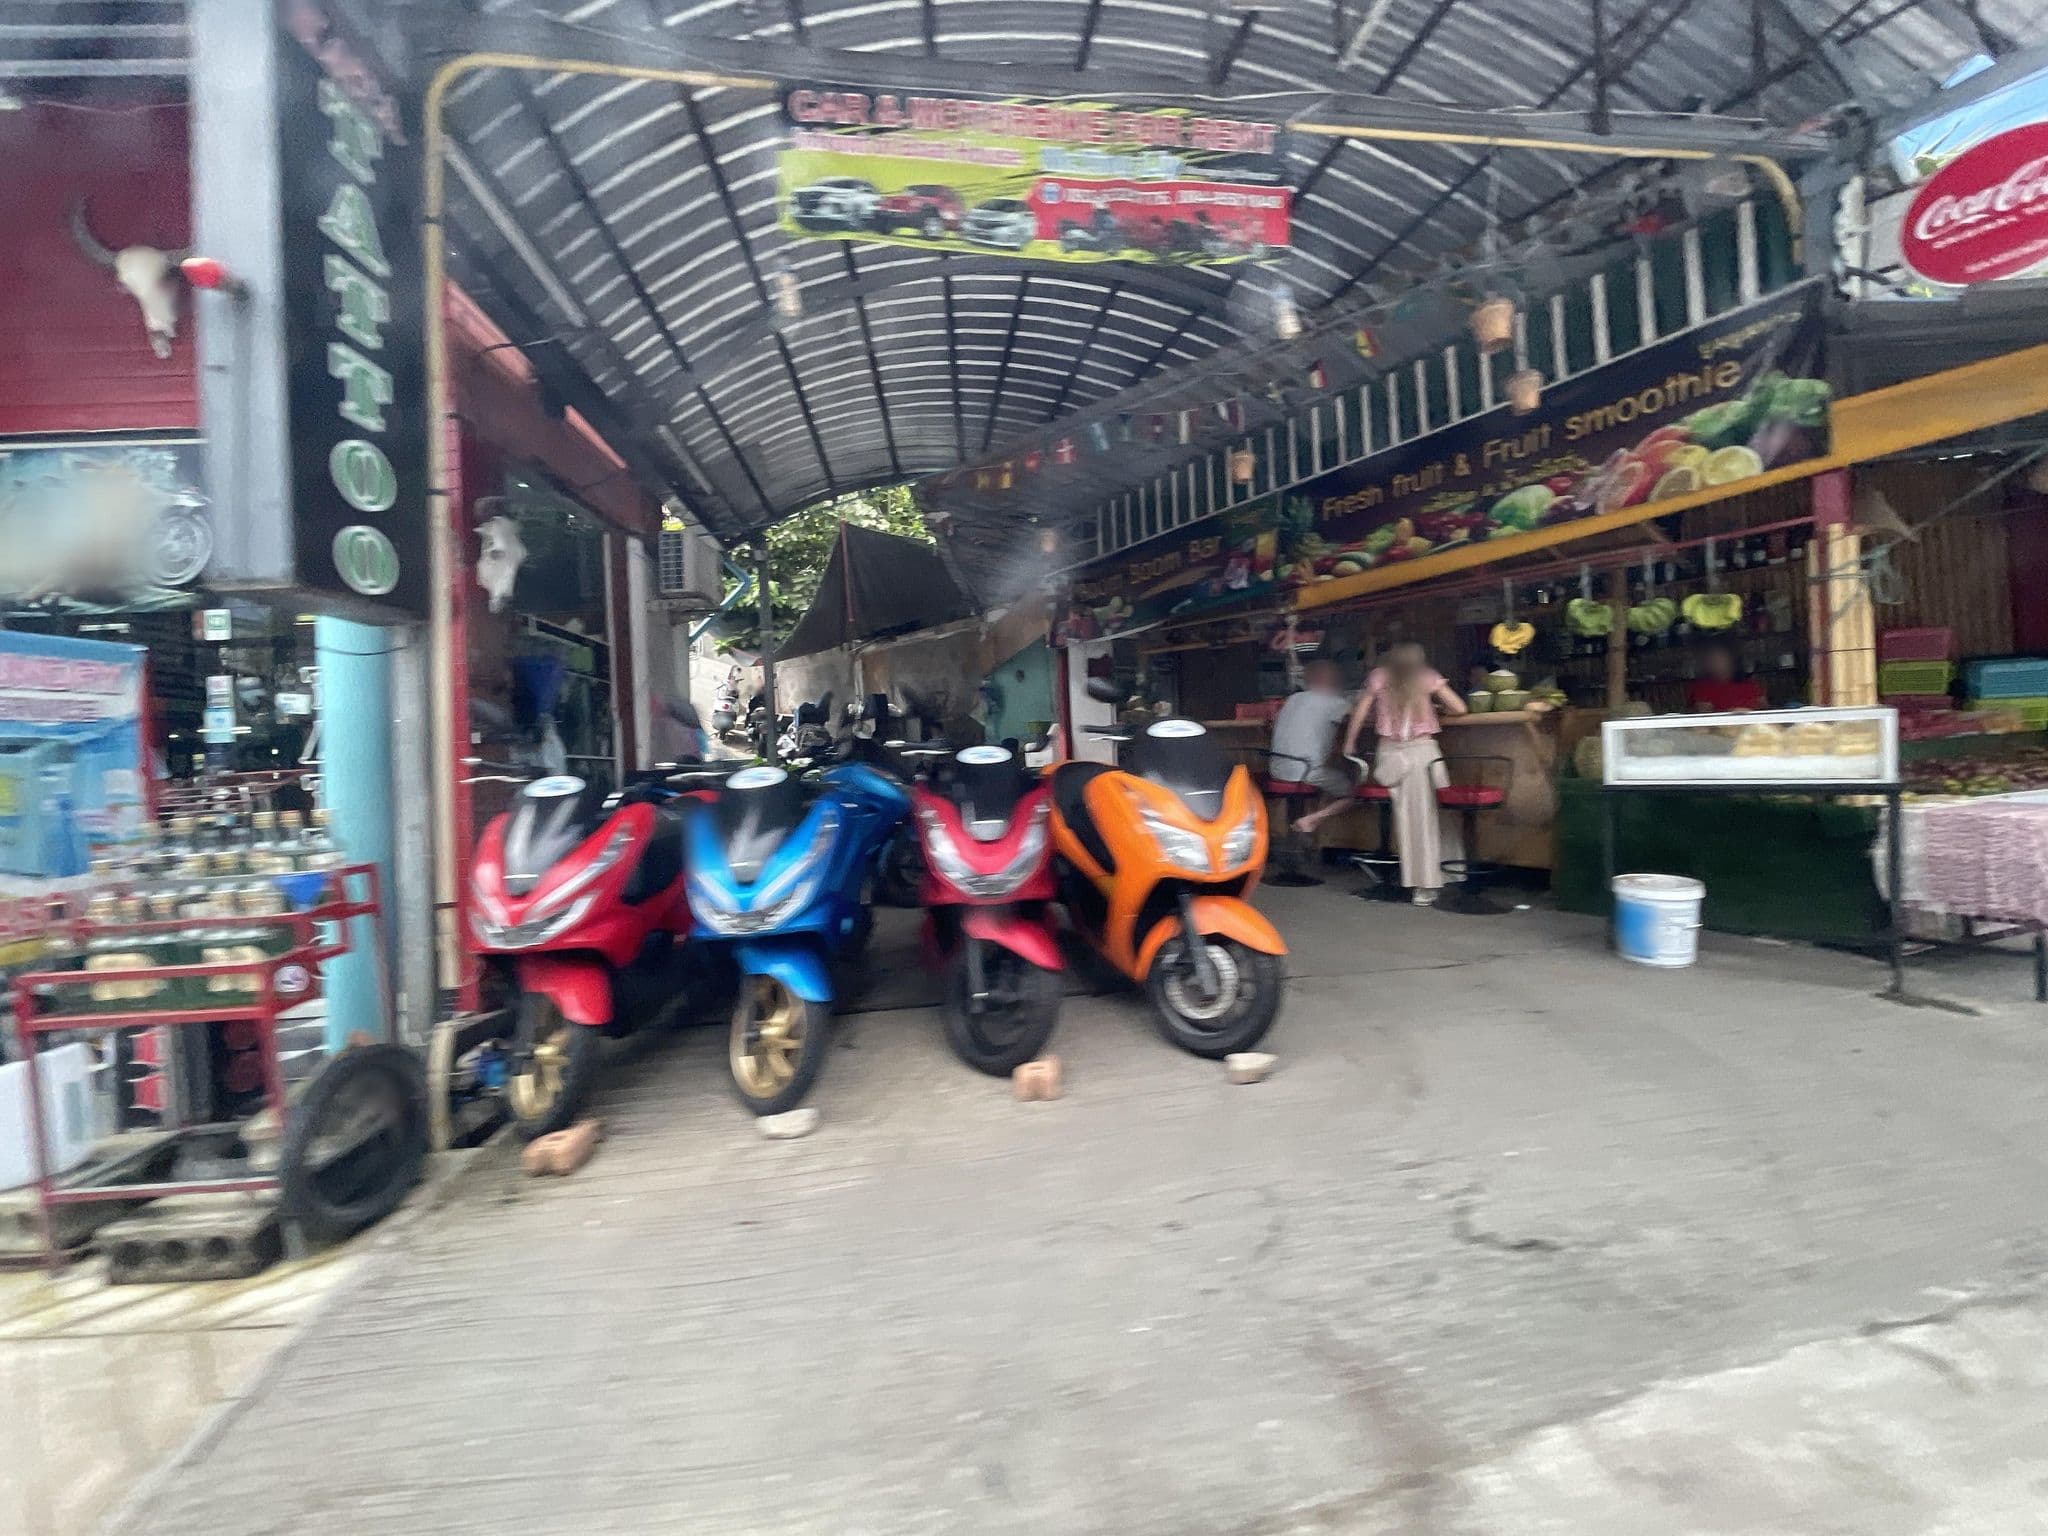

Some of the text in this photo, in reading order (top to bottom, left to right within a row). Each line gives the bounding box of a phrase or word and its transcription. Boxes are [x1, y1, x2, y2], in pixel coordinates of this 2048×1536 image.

[788, 90, 870, 124] CAR
[1322, 486, 1383, 521] Fresh
[1391, 462, 1444, 497] fruit
[1455, 452, 1472, 477] &
[1483, 423, 1551, 469] Fruit
[1564, 359, 1743, 441] smoothie
